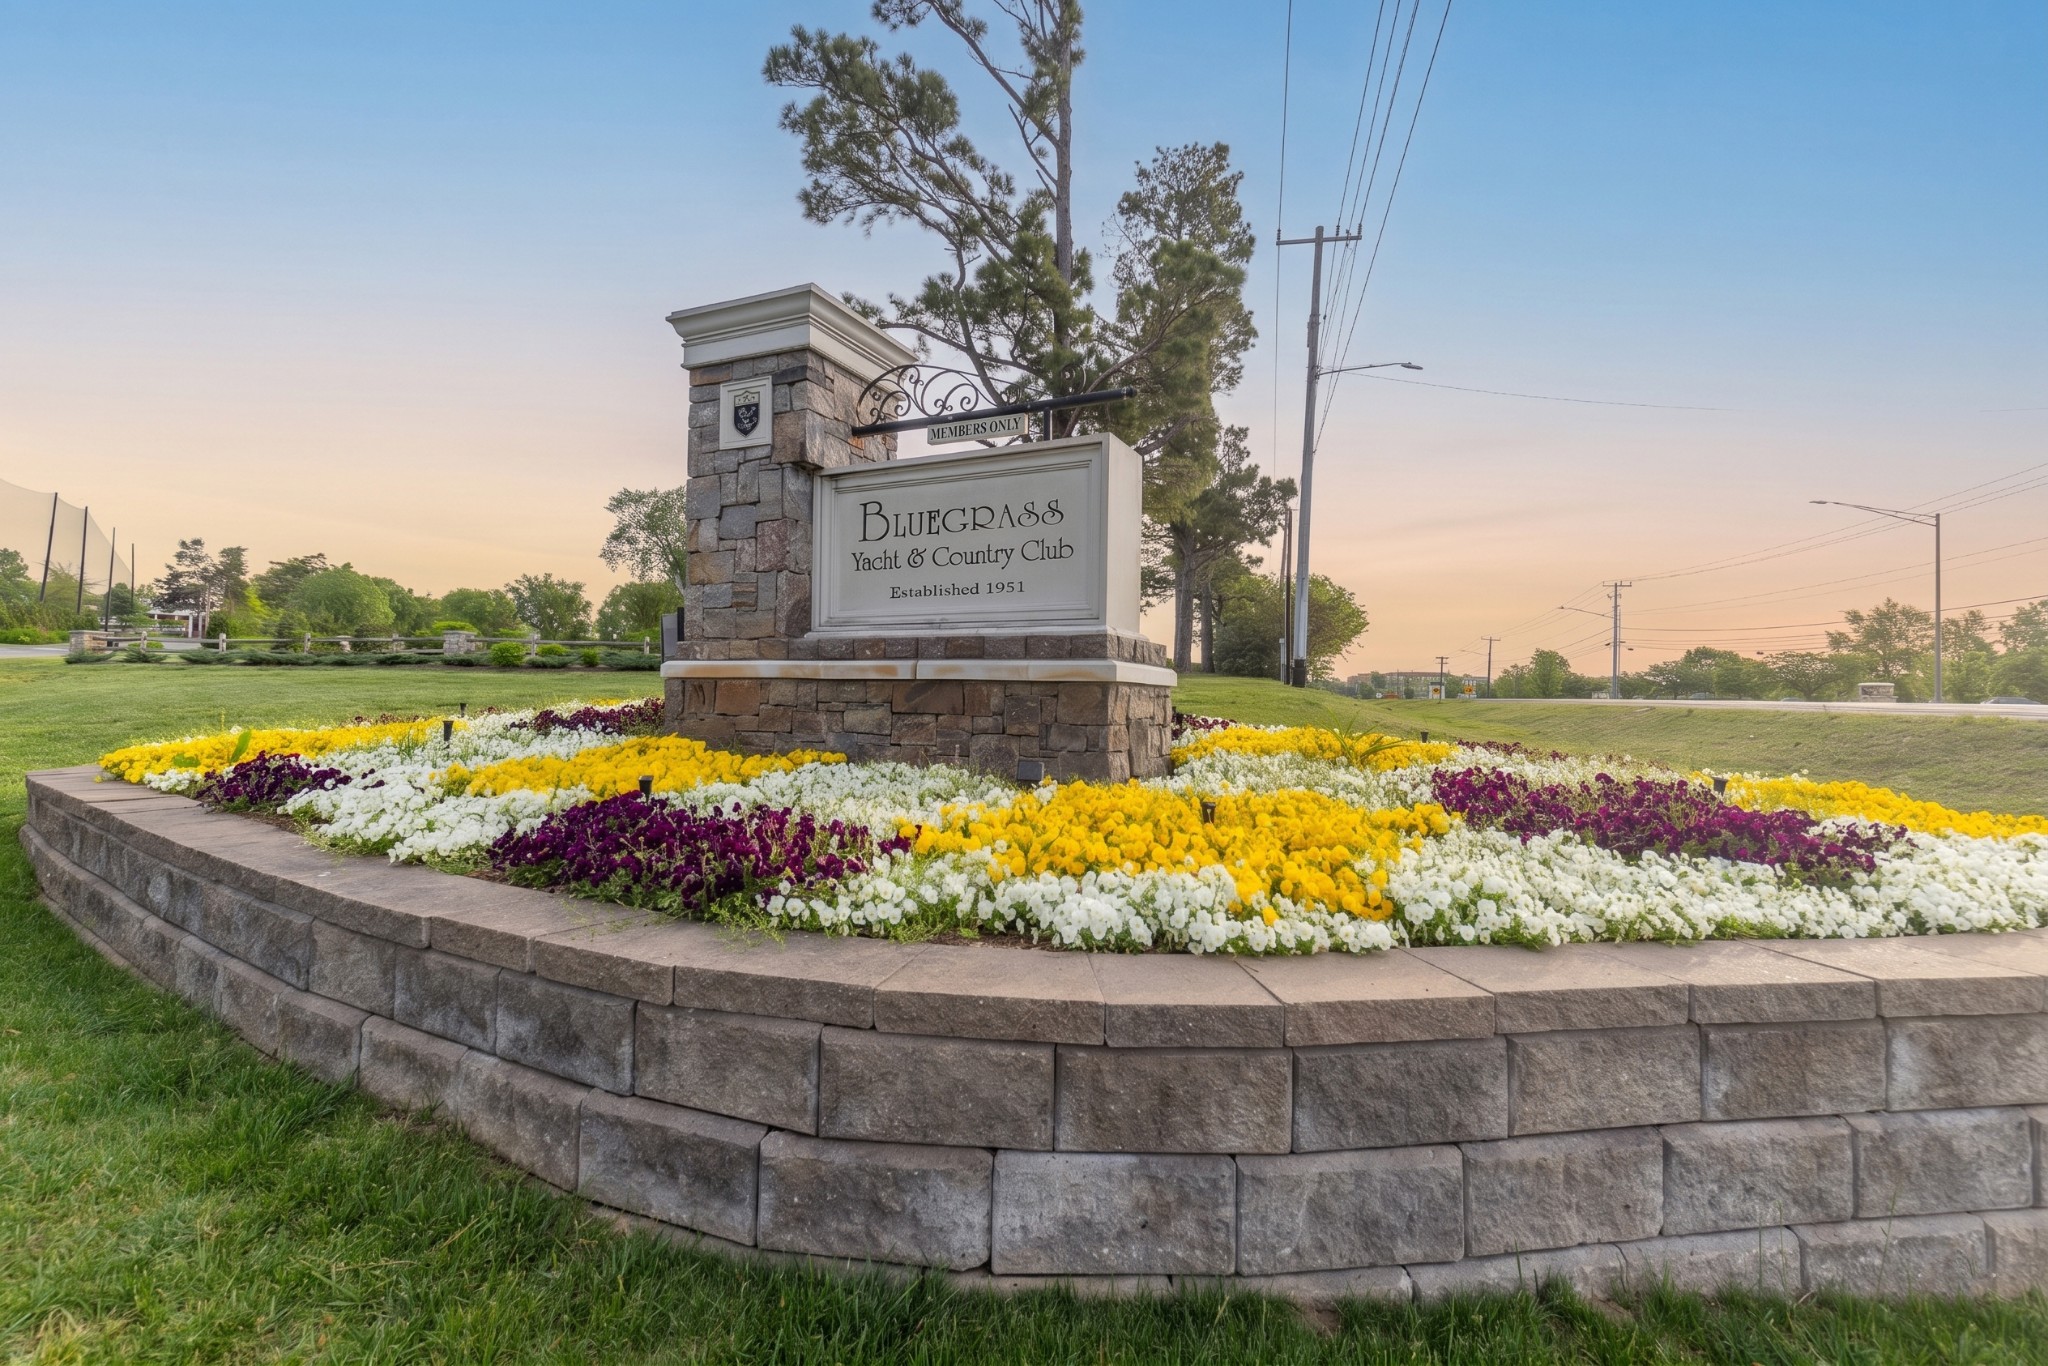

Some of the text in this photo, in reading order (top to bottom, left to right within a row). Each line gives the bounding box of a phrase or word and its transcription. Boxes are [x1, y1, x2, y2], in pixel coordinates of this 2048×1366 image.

[930, 417, 1022, 440] MEMBERS ONLY
[858, 499, 1064, 542] BLUEGRASS
[851, 537, 1074, 571] Yacht & Country Club
[890, 581, 1025, 599] Established 1951
